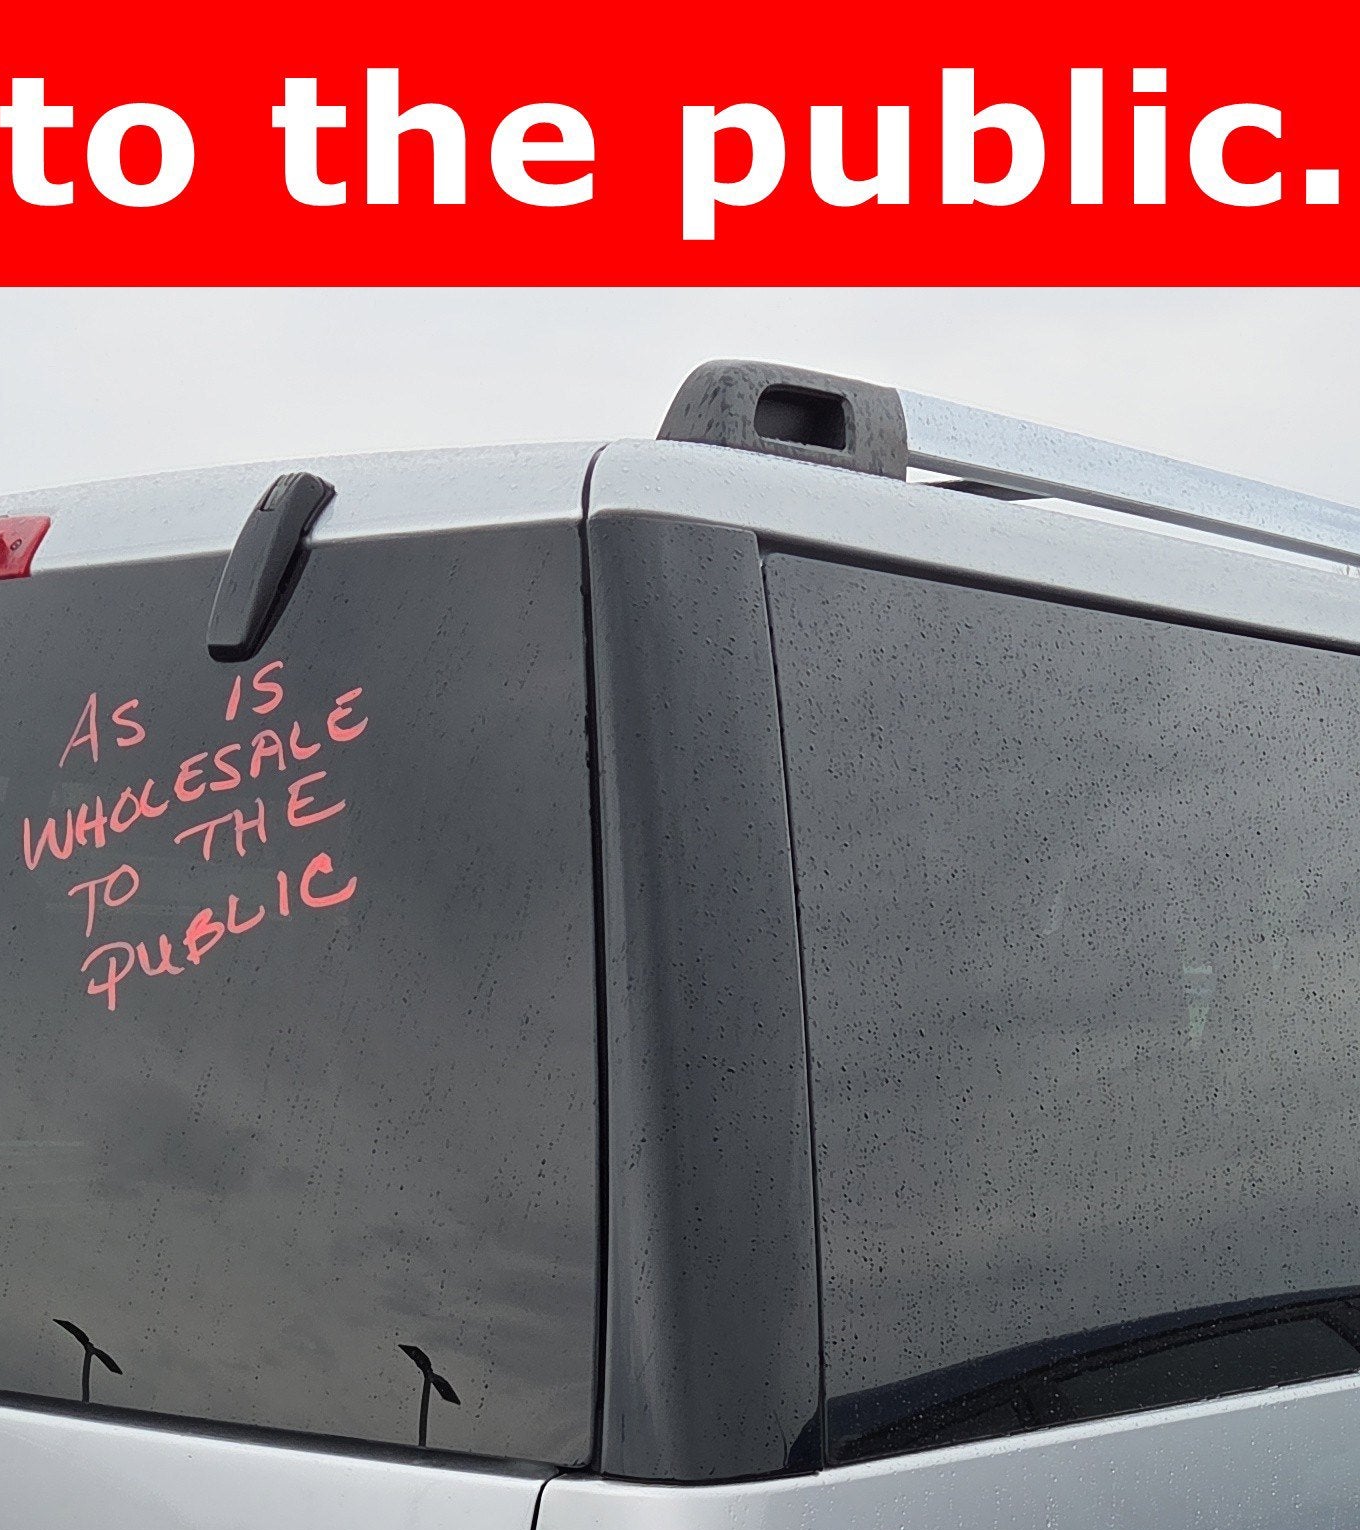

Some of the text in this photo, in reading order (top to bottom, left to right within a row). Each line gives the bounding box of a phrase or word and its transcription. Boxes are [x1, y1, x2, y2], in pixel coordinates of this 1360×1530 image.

[23, 687, 369, 870] WHOLESALE
[58, 660, 285, 768] AS IS
[68, 770, 346, 938] TO THE
[80, 852, 358, 1011] PUBLIC
